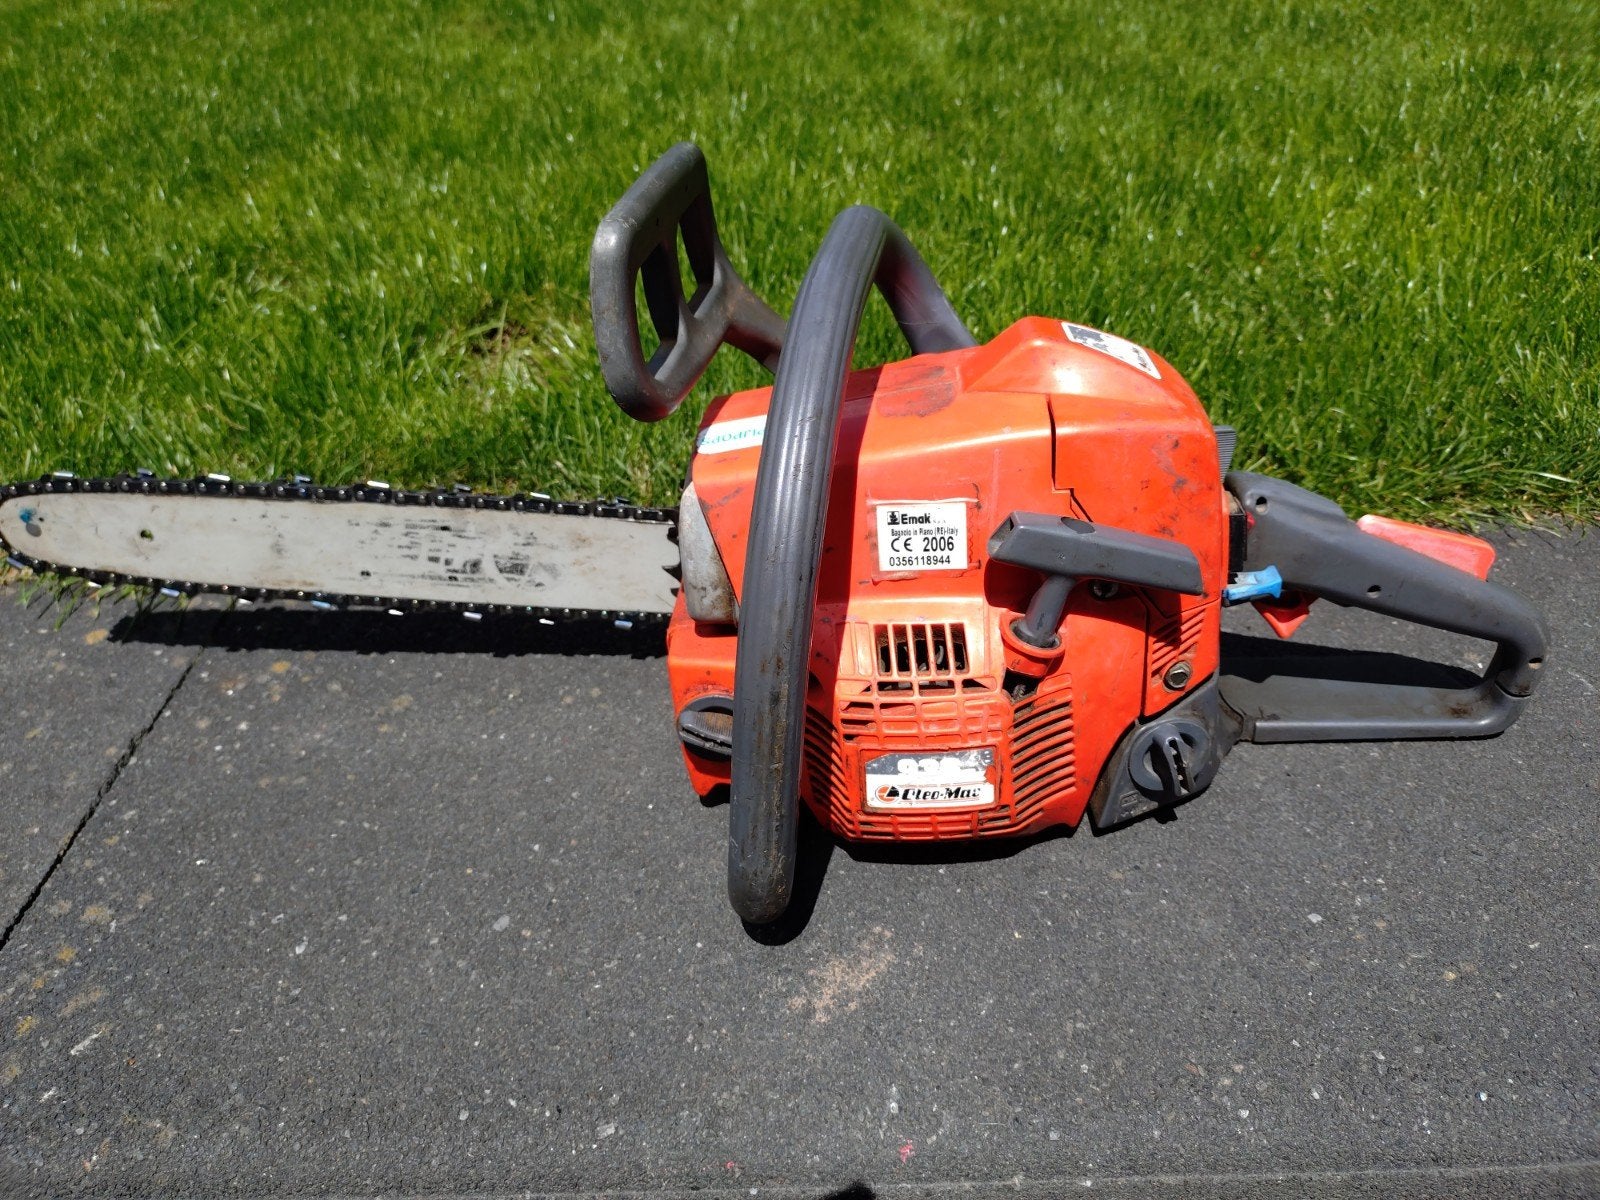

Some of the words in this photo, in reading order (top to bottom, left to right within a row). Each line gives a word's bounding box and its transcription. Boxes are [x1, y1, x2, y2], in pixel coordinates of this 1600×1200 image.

[901, 513, 931, 525] Emak
[922, 536, 955, 552] 2006
[889, 555, 951, 567] 0356118944
